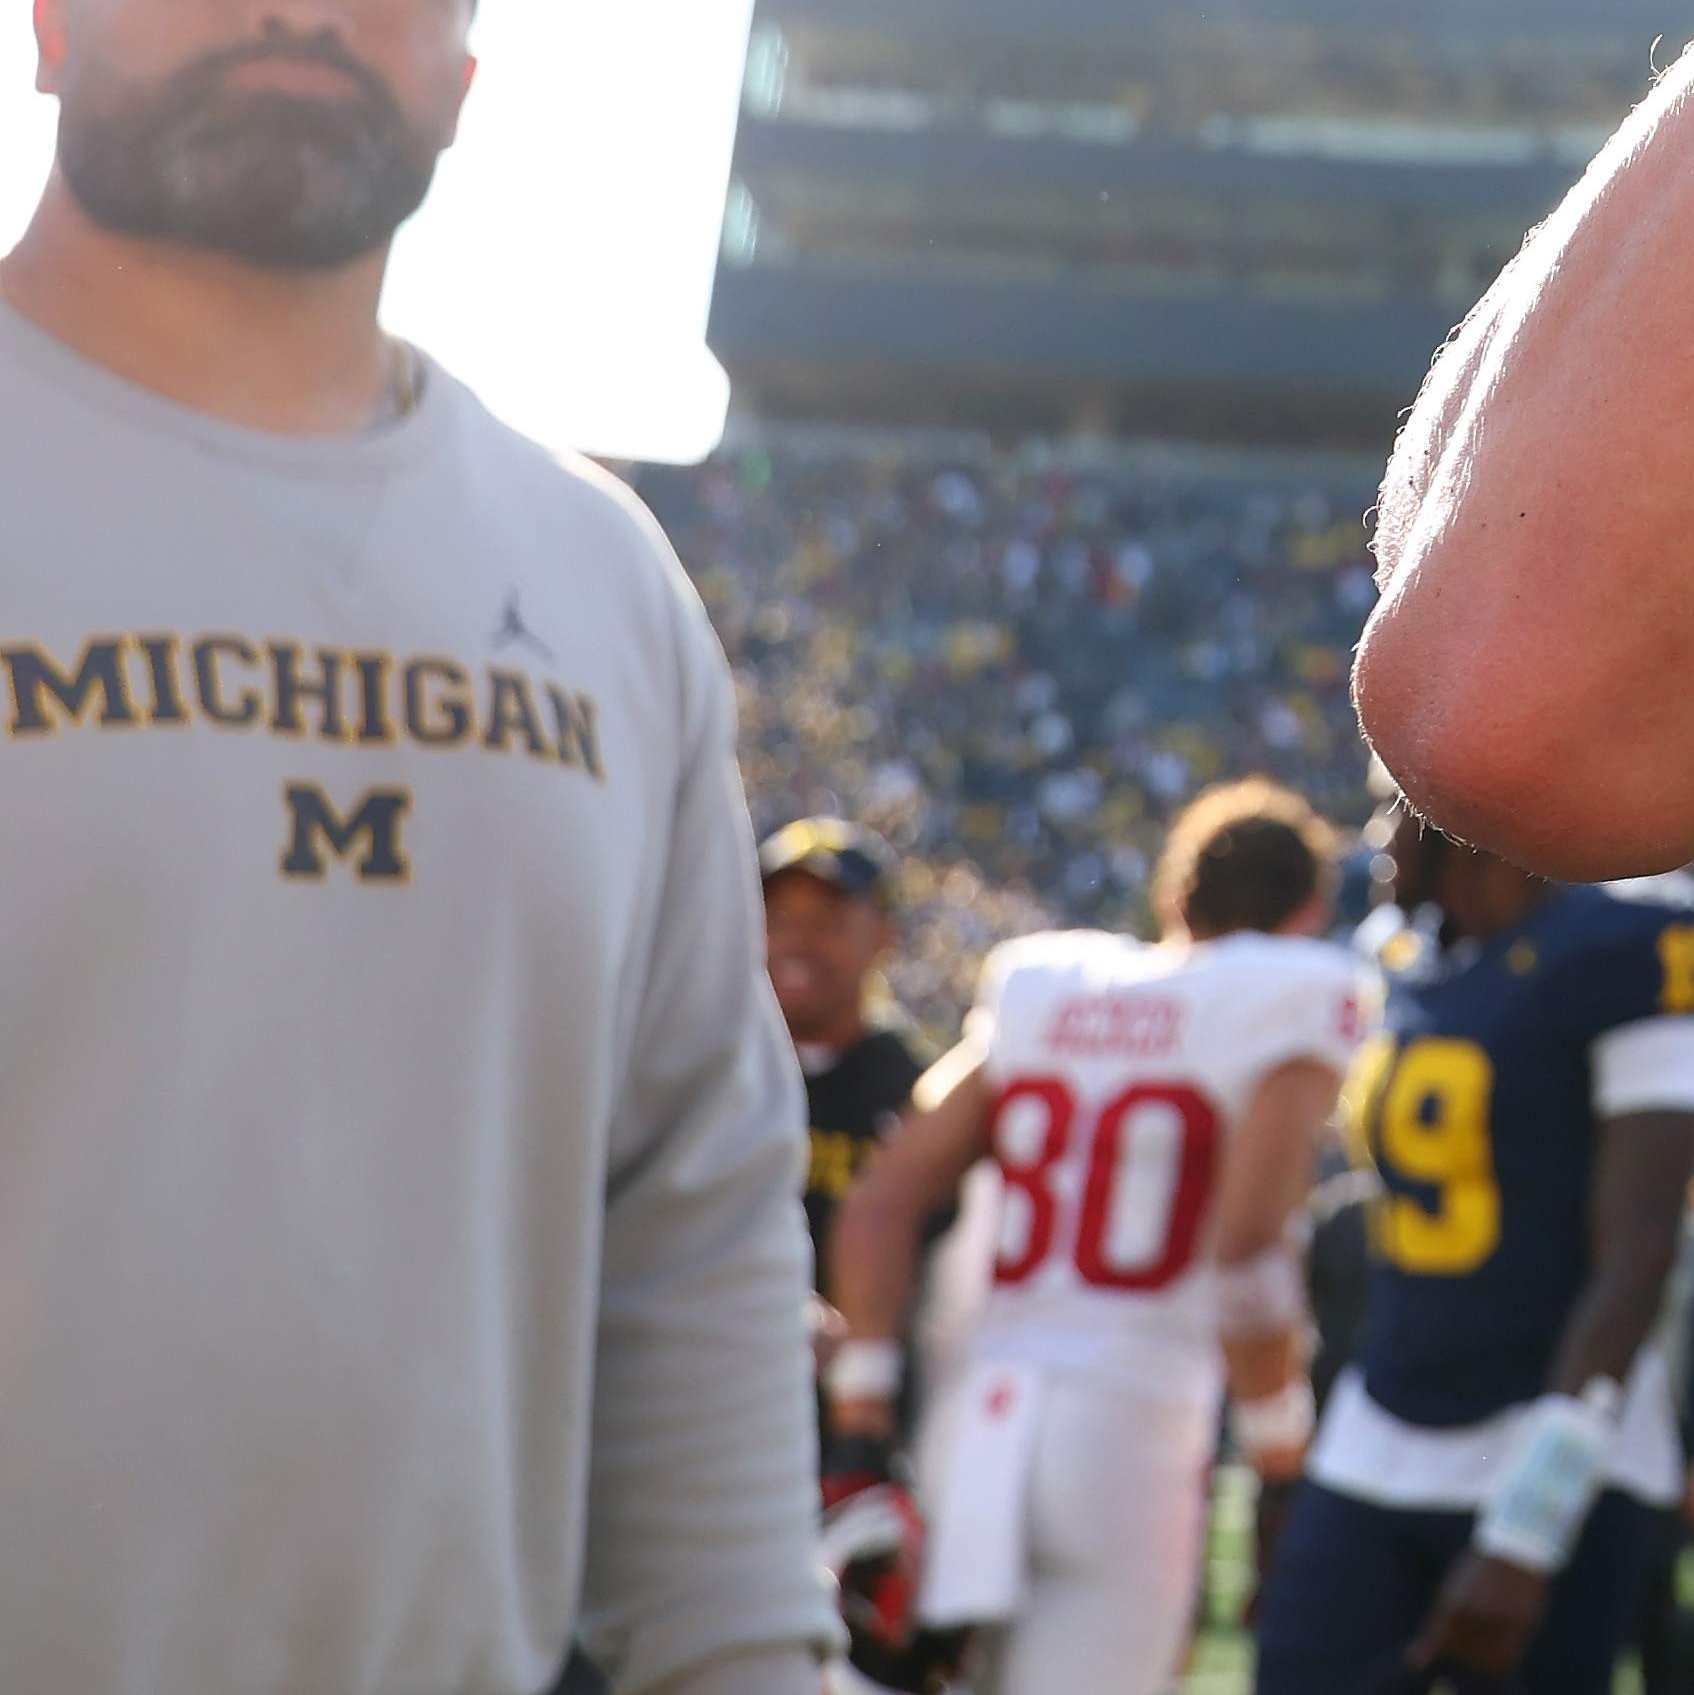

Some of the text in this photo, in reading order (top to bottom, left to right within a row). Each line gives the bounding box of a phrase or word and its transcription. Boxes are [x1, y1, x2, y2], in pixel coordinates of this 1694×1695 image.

[0, 631, 606, 787] MICHIGAN
[279, 775, 415, 886] M
[988, 1074, 1222, 1292] 80
